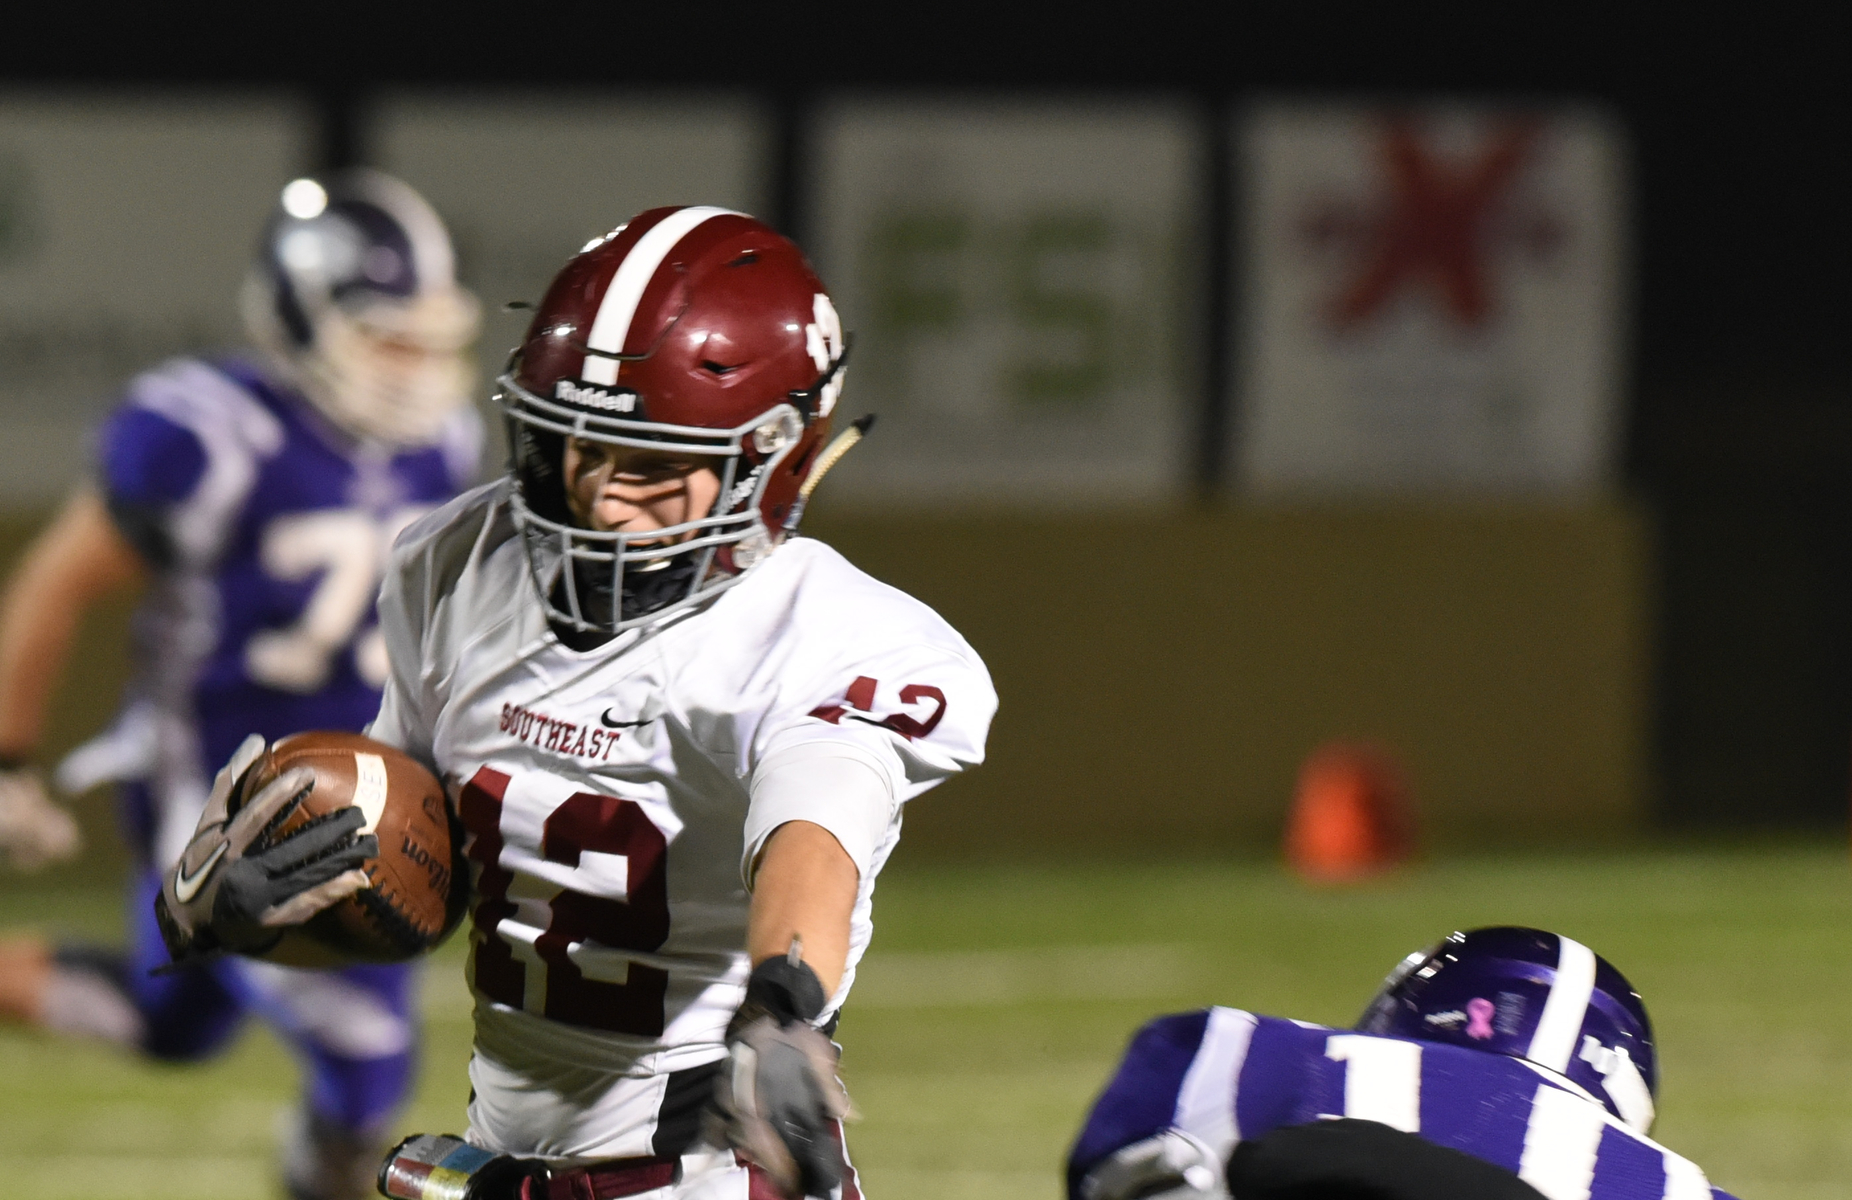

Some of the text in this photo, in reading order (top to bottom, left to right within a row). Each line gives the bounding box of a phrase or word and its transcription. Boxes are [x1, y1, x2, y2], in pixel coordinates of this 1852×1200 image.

[554, 380, 637, 413] Riddell
[244, 506, 418, 692] 7
[499, 701, 621, 761] SOUTHEAST
[401, 833, 451, 899] ilson
[459, 764, 671, 1038] 12
